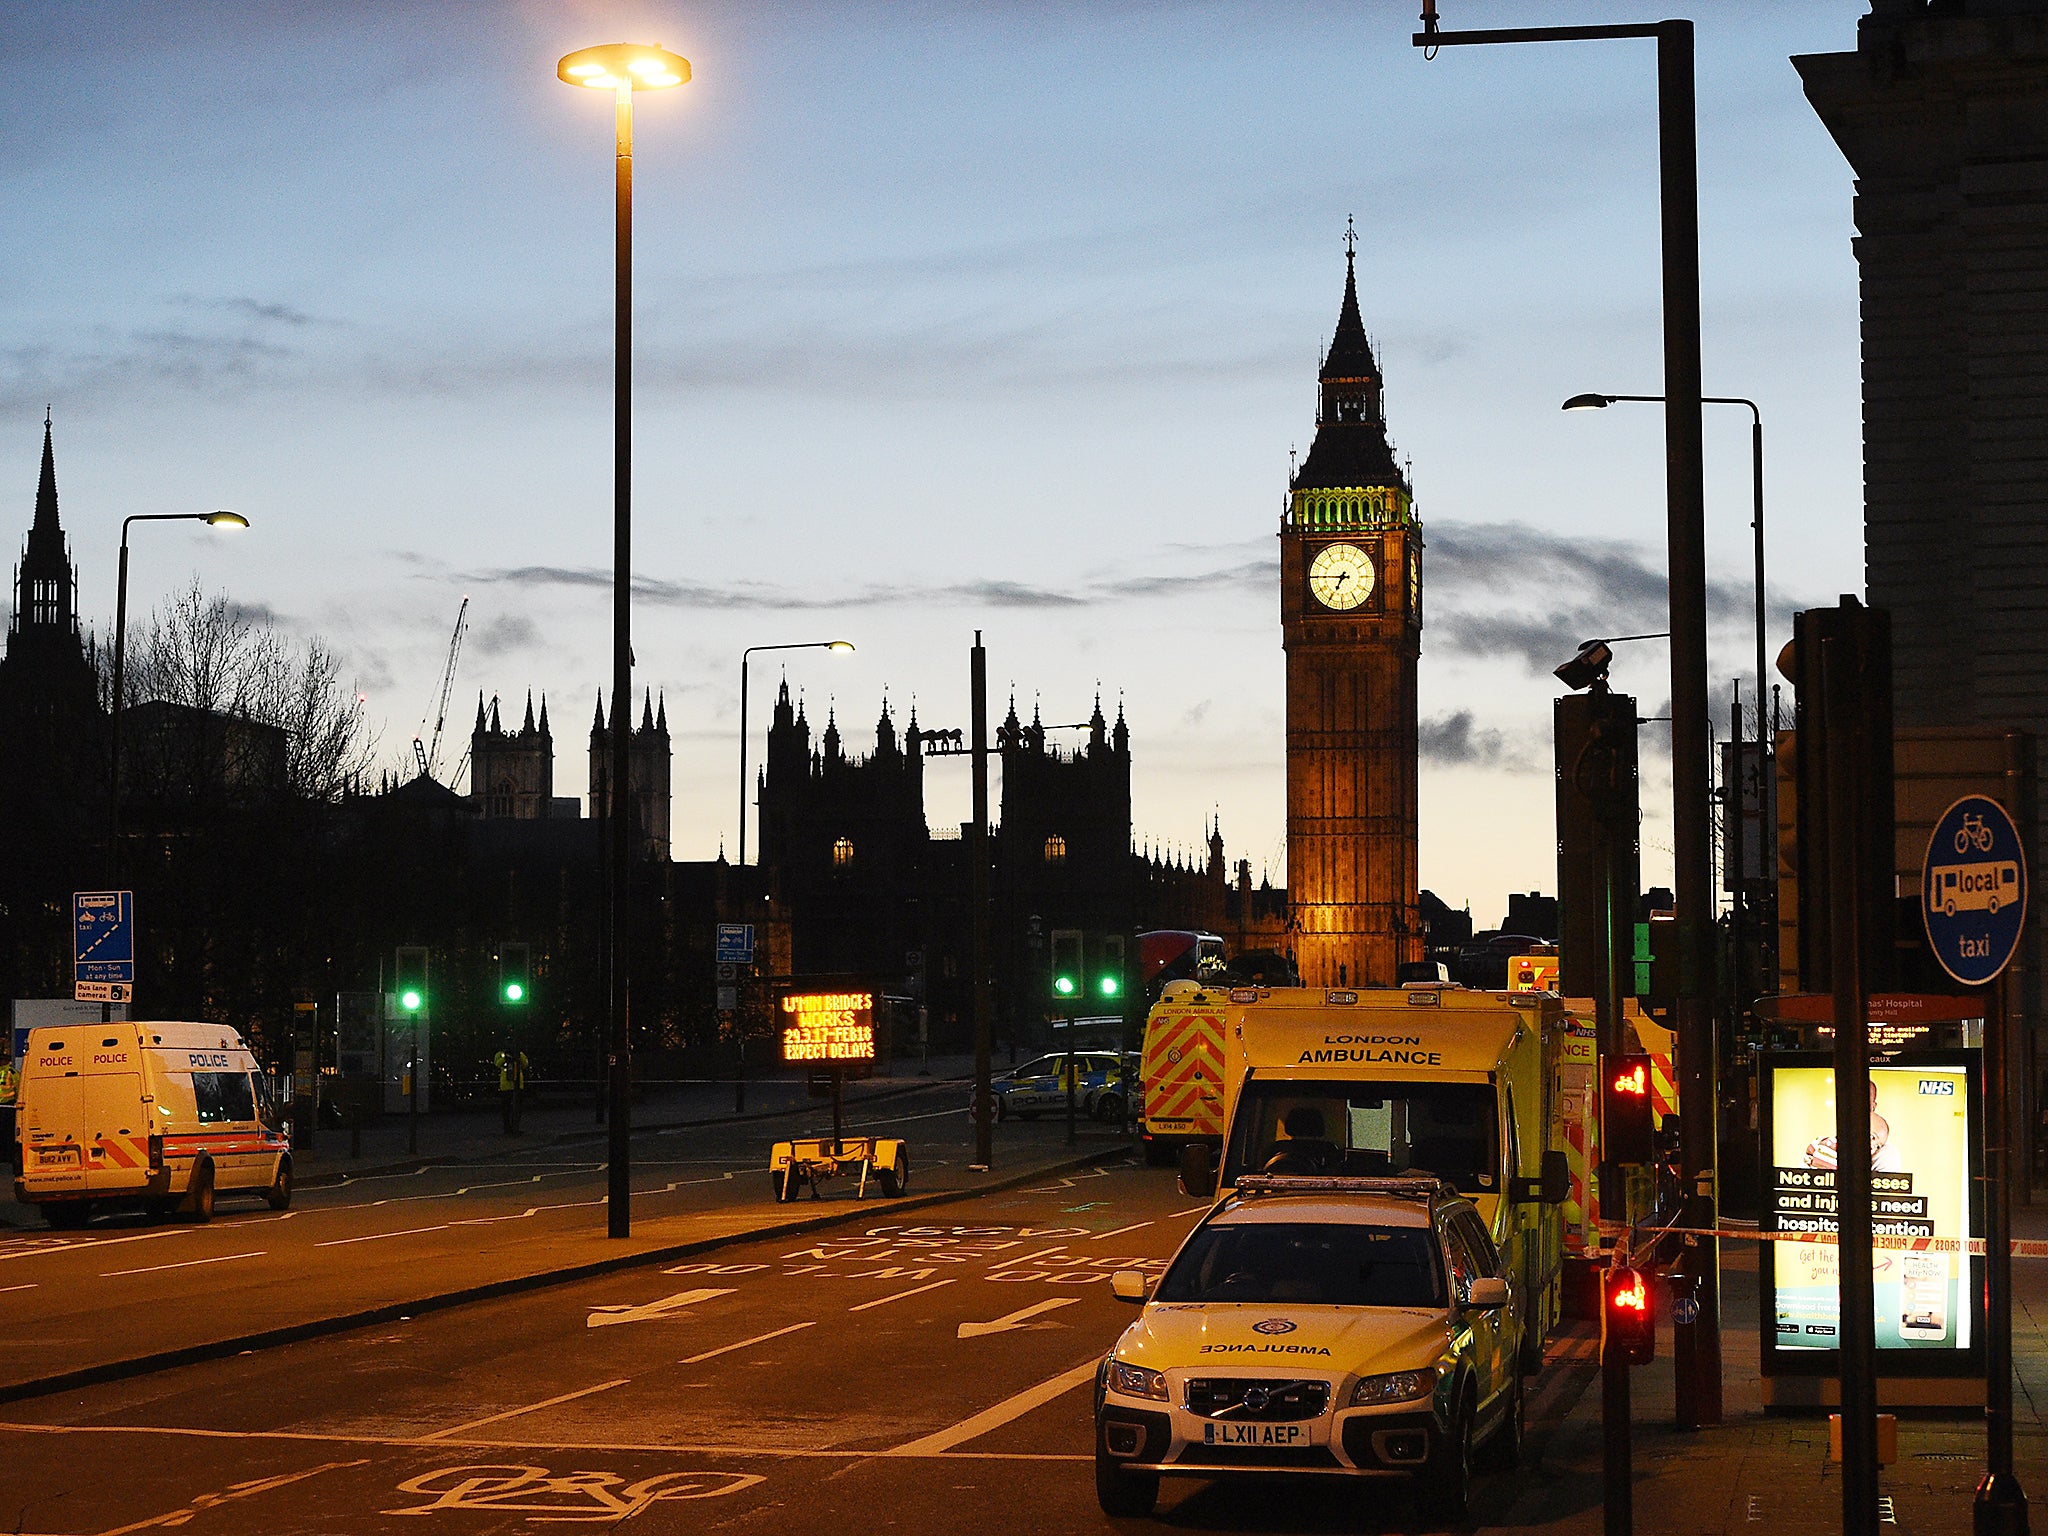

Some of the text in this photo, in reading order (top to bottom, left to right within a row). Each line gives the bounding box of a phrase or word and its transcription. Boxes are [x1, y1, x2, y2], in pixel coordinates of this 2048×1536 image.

[1959, 867, 1999, 893] local
[1959, 933, 1990, 958] taxi
[824, 993, 873, 1010] BRIDGES
[1885, 1000, 1923, 1009] Hospital
[799, 1011, 856, 1027] WORKS
[1575, 1027, 1597, 1037] NHS
[1324, 1035, 1420, 1046] LONDON
[94, 1053, 128, 1064] POLICE
[784, 1042, 875, 1060] EXPECT DELAYS
[1298, 1049, 1442, 1066] AMBULANCE
[40, 1056, 73, 1067] POLICE
[189, 1054, 229, 1067] POLICE
[1919, 1081, 1953, 1095] NHS
[1011, 1095, 1068, 1106] POLIC
[1779, 1170, 1835, 1187] Not all
[1778, 1194, 1812, 1209] and
[1880, 1199, 1923, 1214] need
[1872, 1221, 1930, 1237] tention
[1799, 1248, 1835, 1265] Get the
[1811, 1266, 1829, 1280] you
[1222, 1425, 1300, 1444] LX11 AEP
